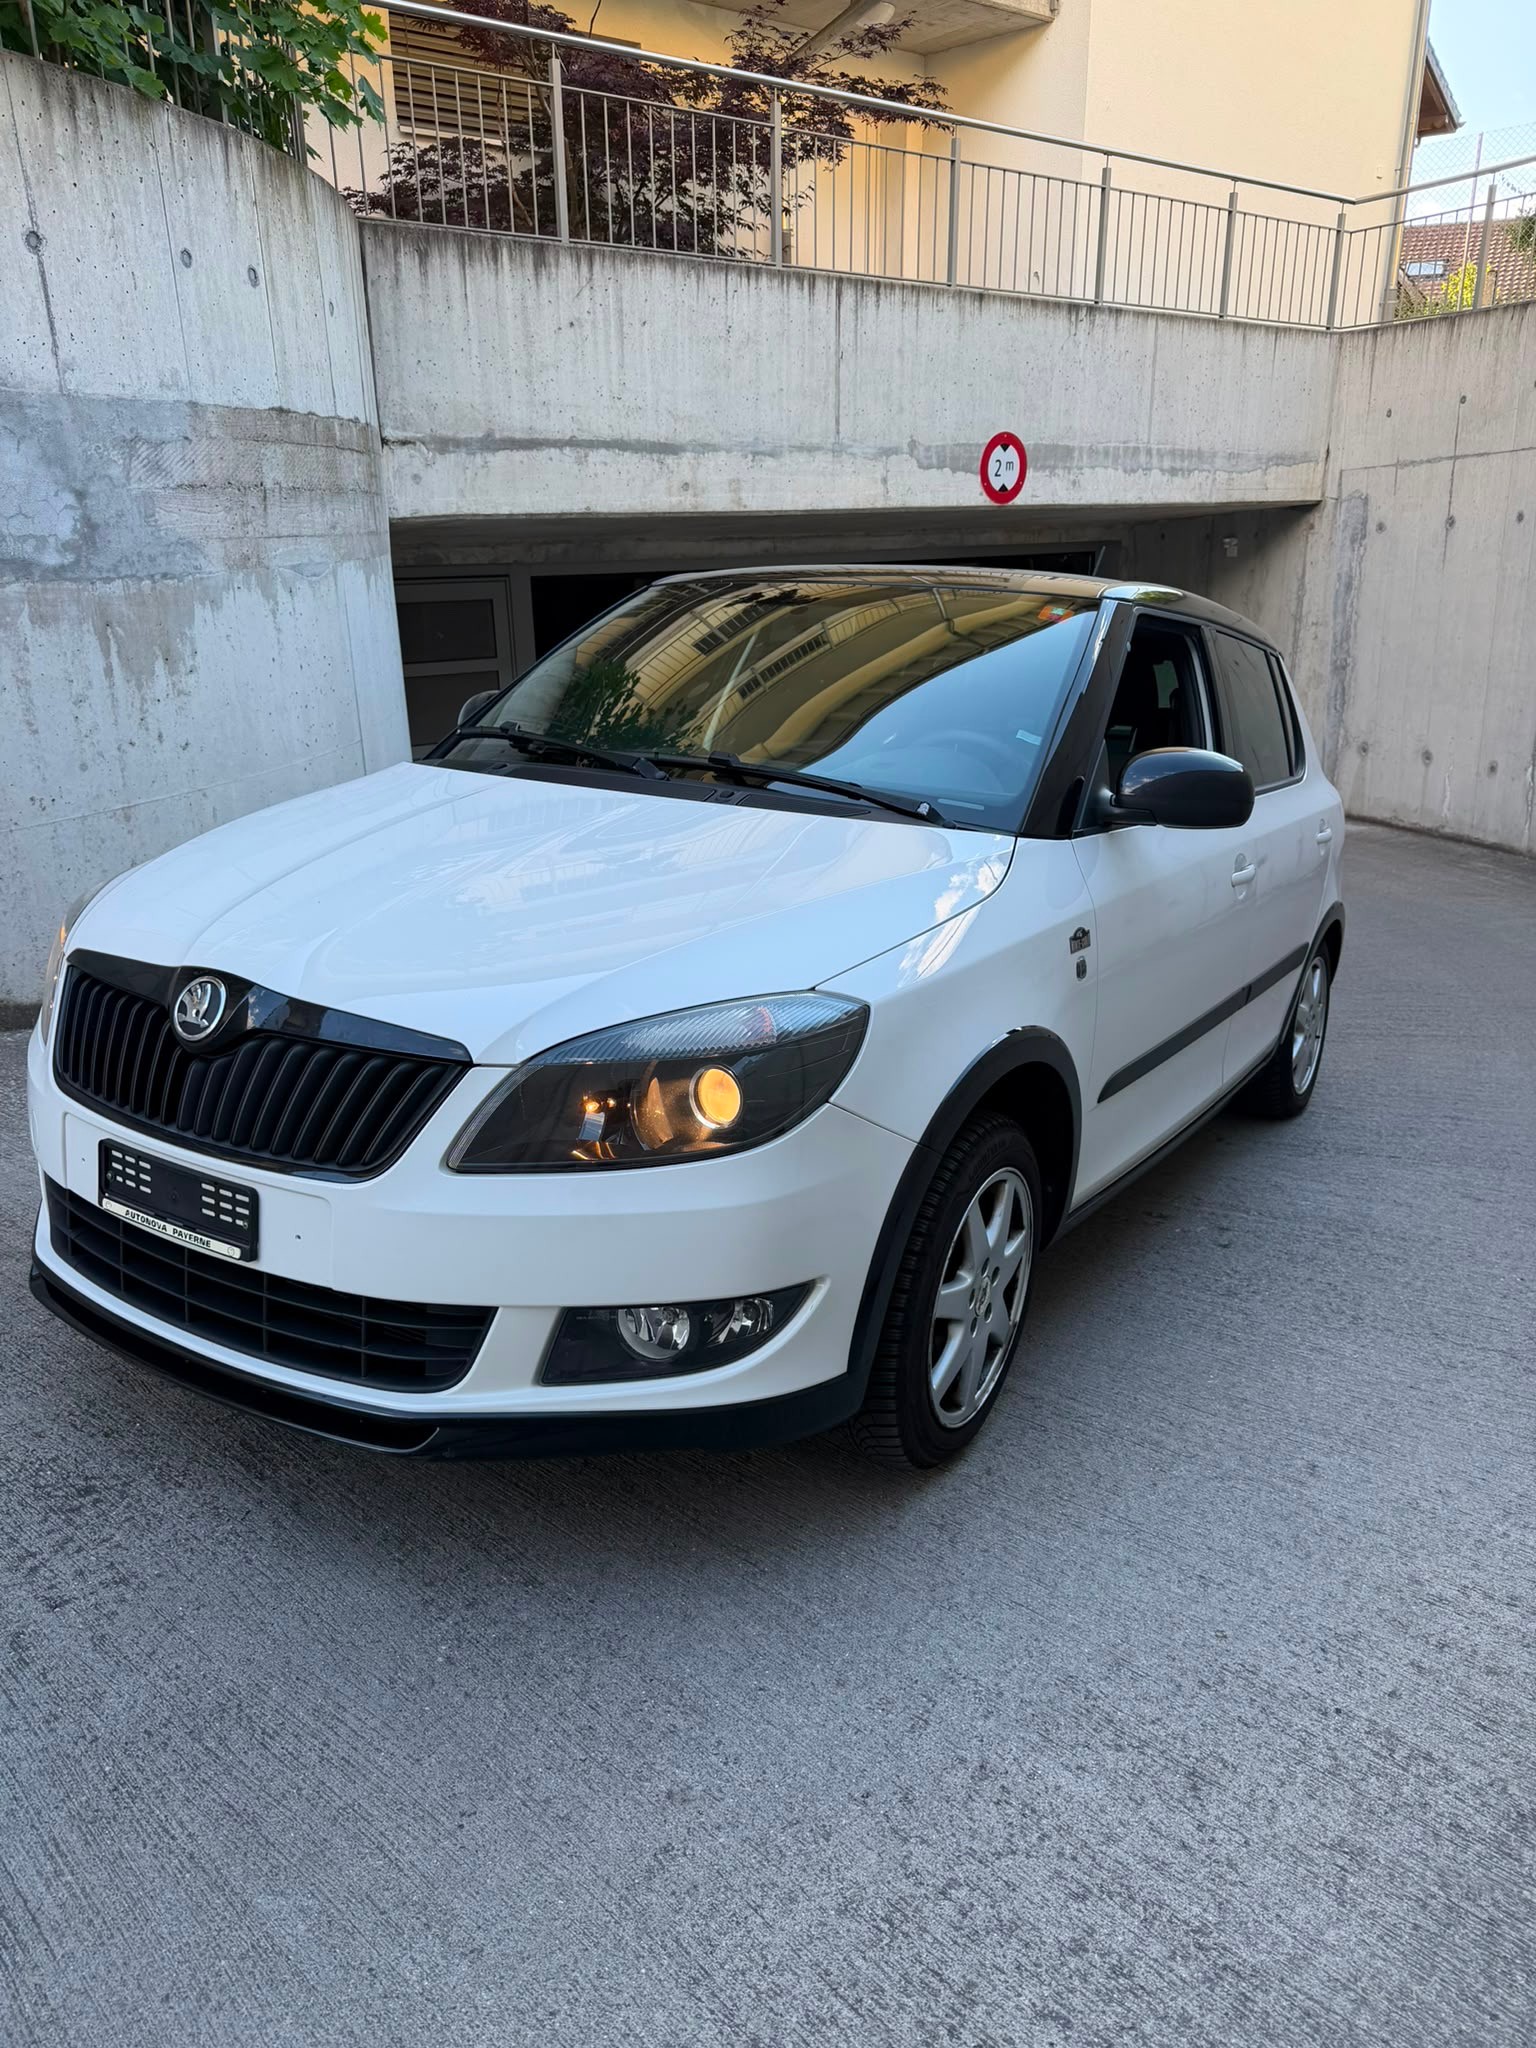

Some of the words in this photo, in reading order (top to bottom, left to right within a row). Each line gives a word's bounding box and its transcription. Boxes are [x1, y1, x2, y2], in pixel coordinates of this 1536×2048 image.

[994, 459, 1002, 477] 2
[1005, 461, 1014, 471] m
[125, 1209, 168, 1232] AUTONOVA
[172, 1228, 211, 1248] PAYERNE
